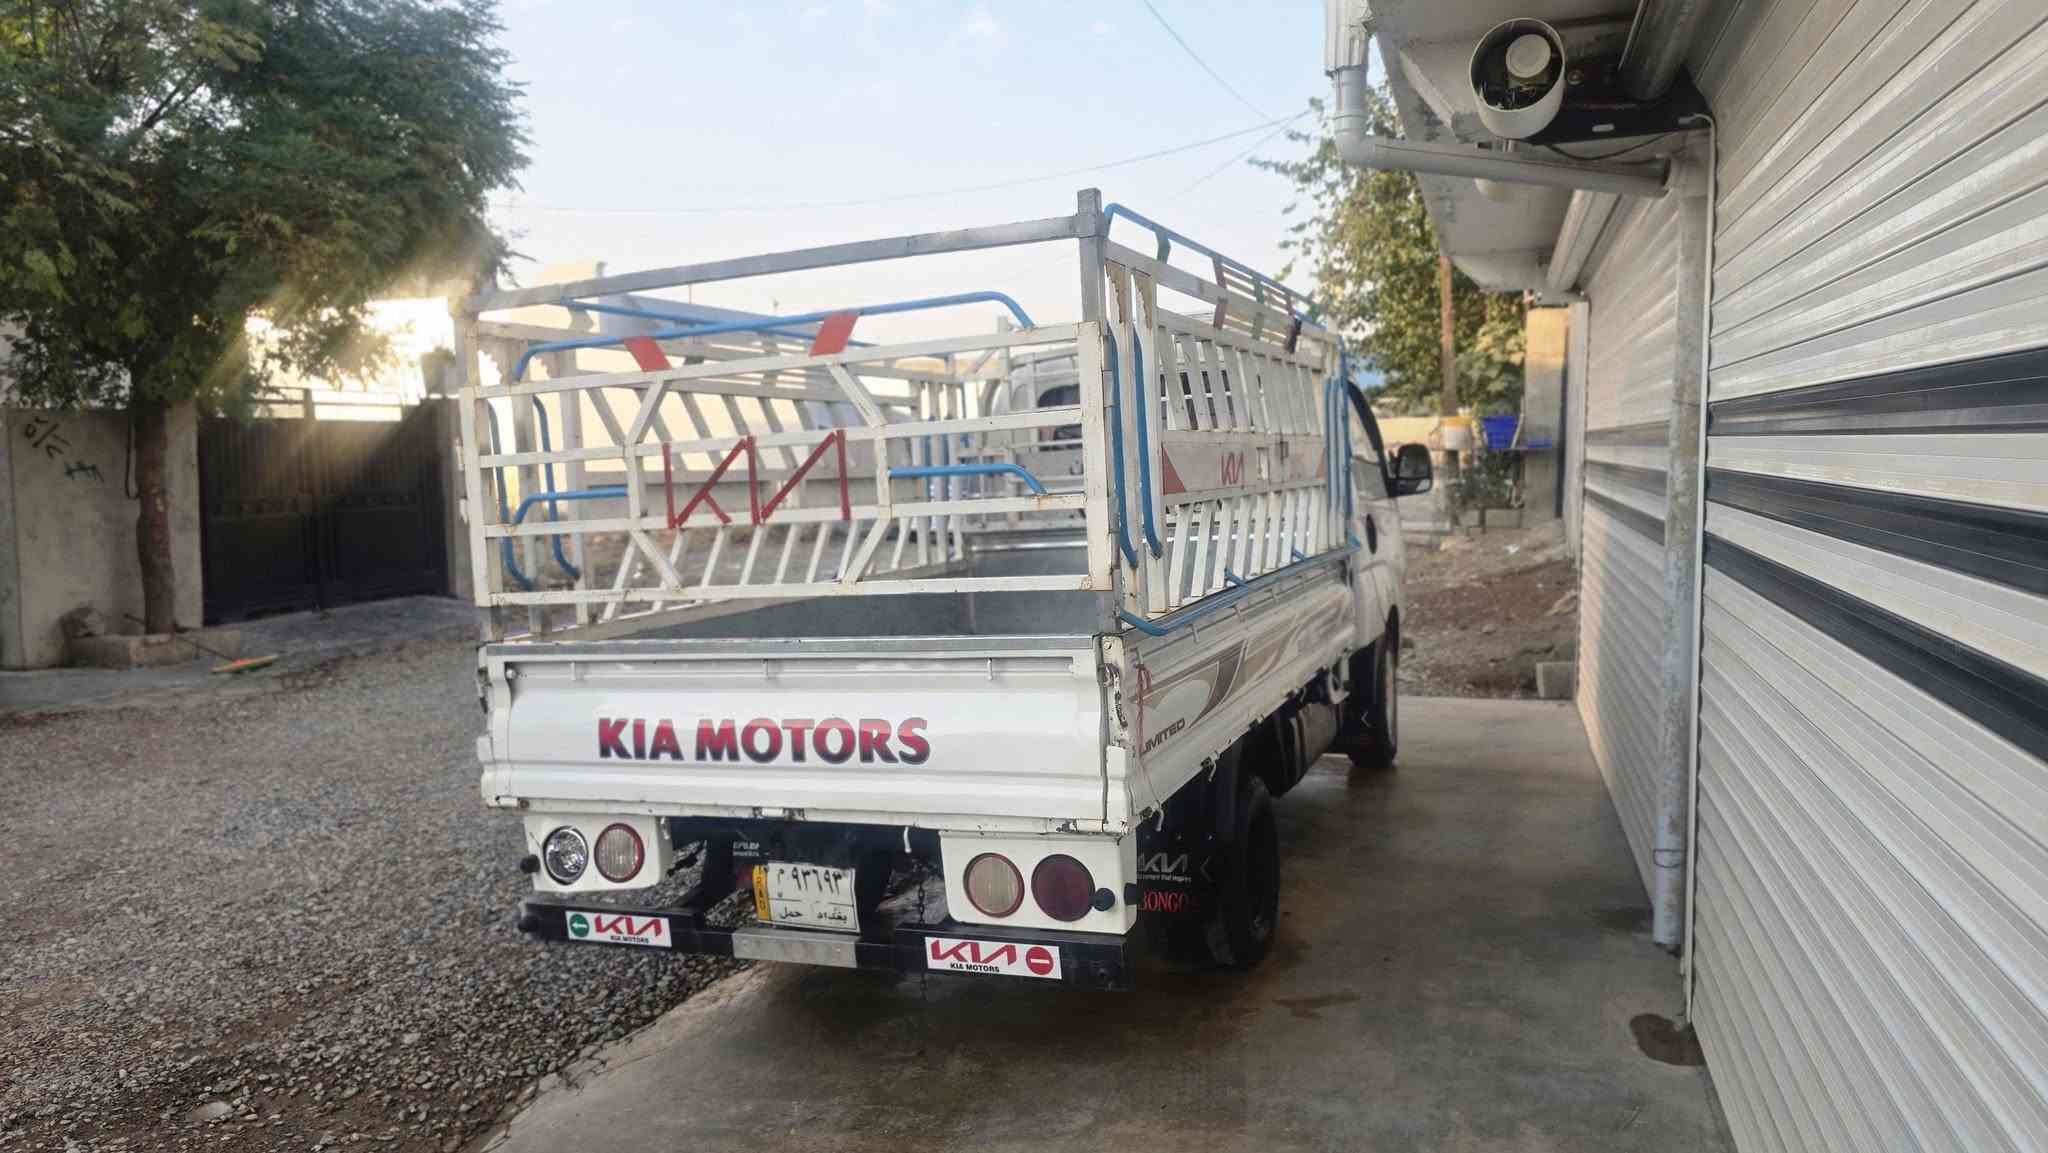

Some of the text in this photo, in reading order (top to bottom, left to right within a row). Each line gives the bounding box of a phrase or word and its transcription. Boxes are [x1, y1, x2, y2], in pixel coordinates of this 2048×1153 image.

[597, 717, 931, 765] KIA MOTORS
[594, 913, 662, 936] KIA
[931, 940, 1016, 965] KIA
[950, 962, 1000, 973] KIA MOTORS
